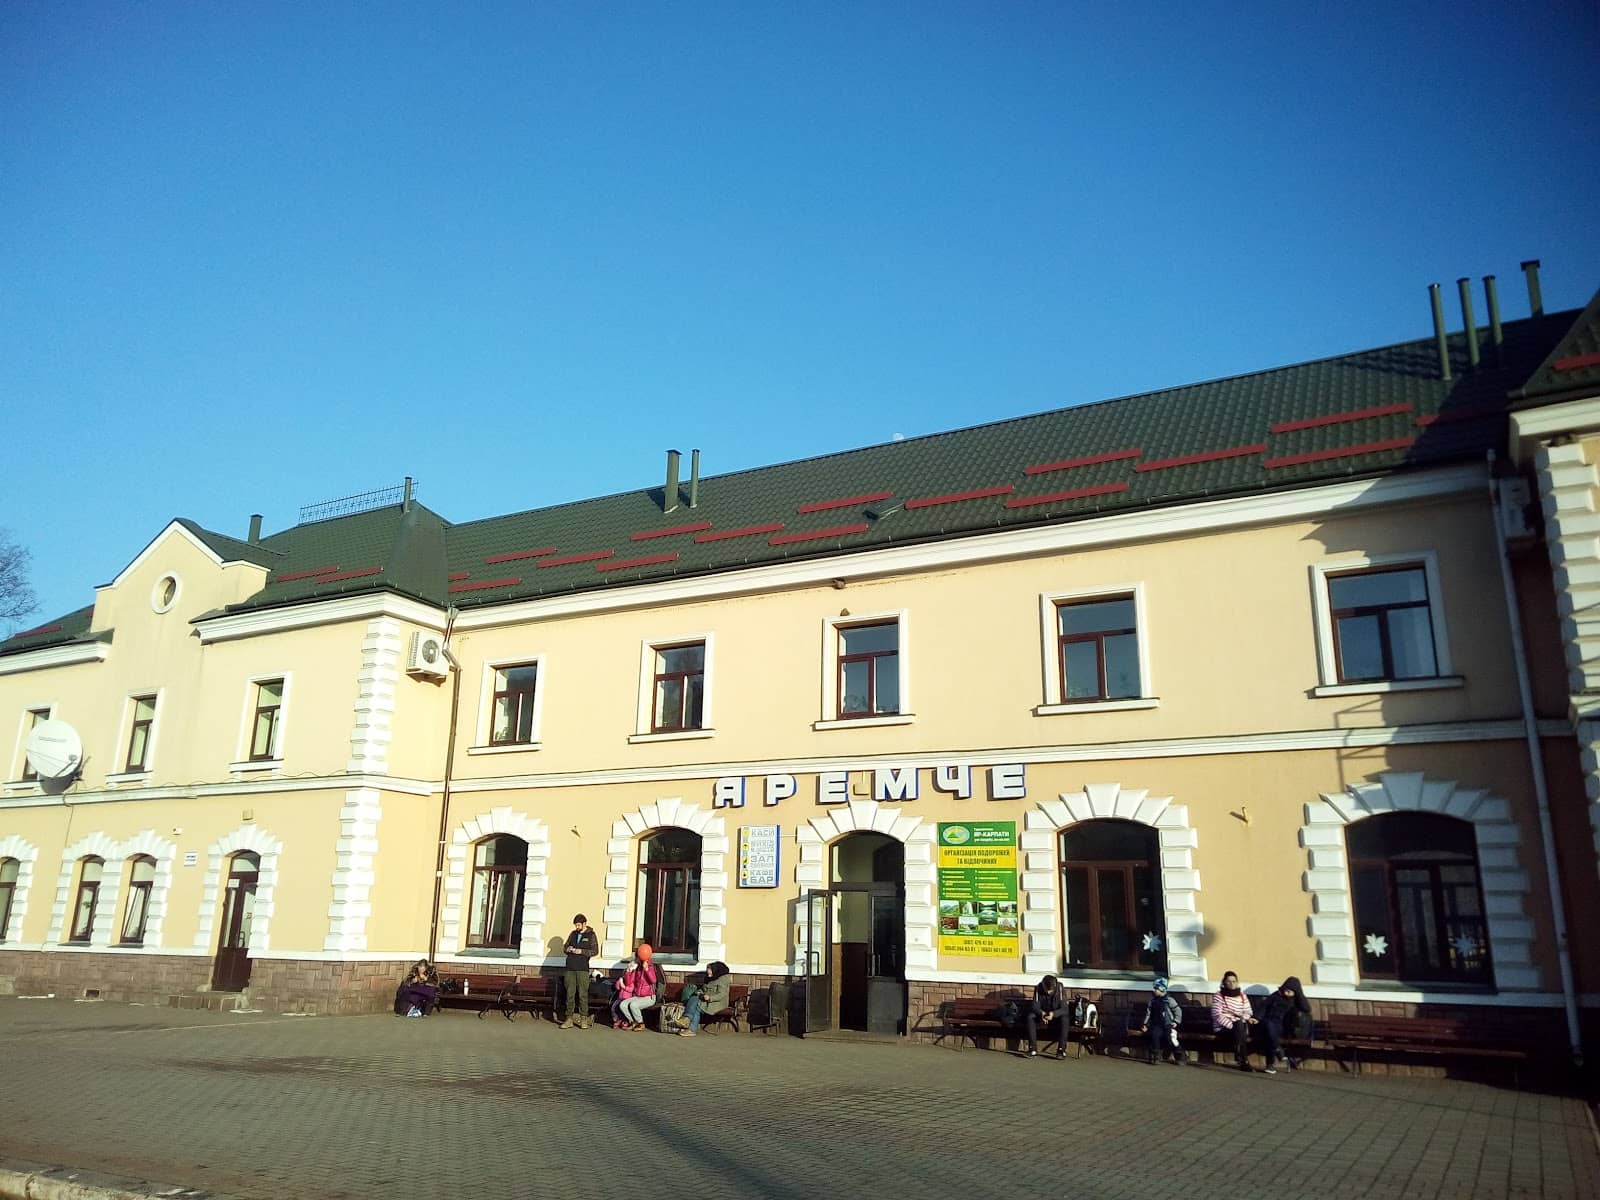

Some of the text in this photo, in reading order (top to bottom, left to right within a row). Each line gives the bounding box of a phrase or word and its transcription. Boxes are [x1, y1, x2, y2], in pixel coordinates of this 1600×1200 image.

[713, 763, 1025, 807] ЯРЕМЧЕ
[751, 828, 775, 837] КАСИ
[750, 855, 774, 864] ЗАЛ
[750, 869, 774, 877] КАФЕ
[750, 876, 774, 885] БАР
